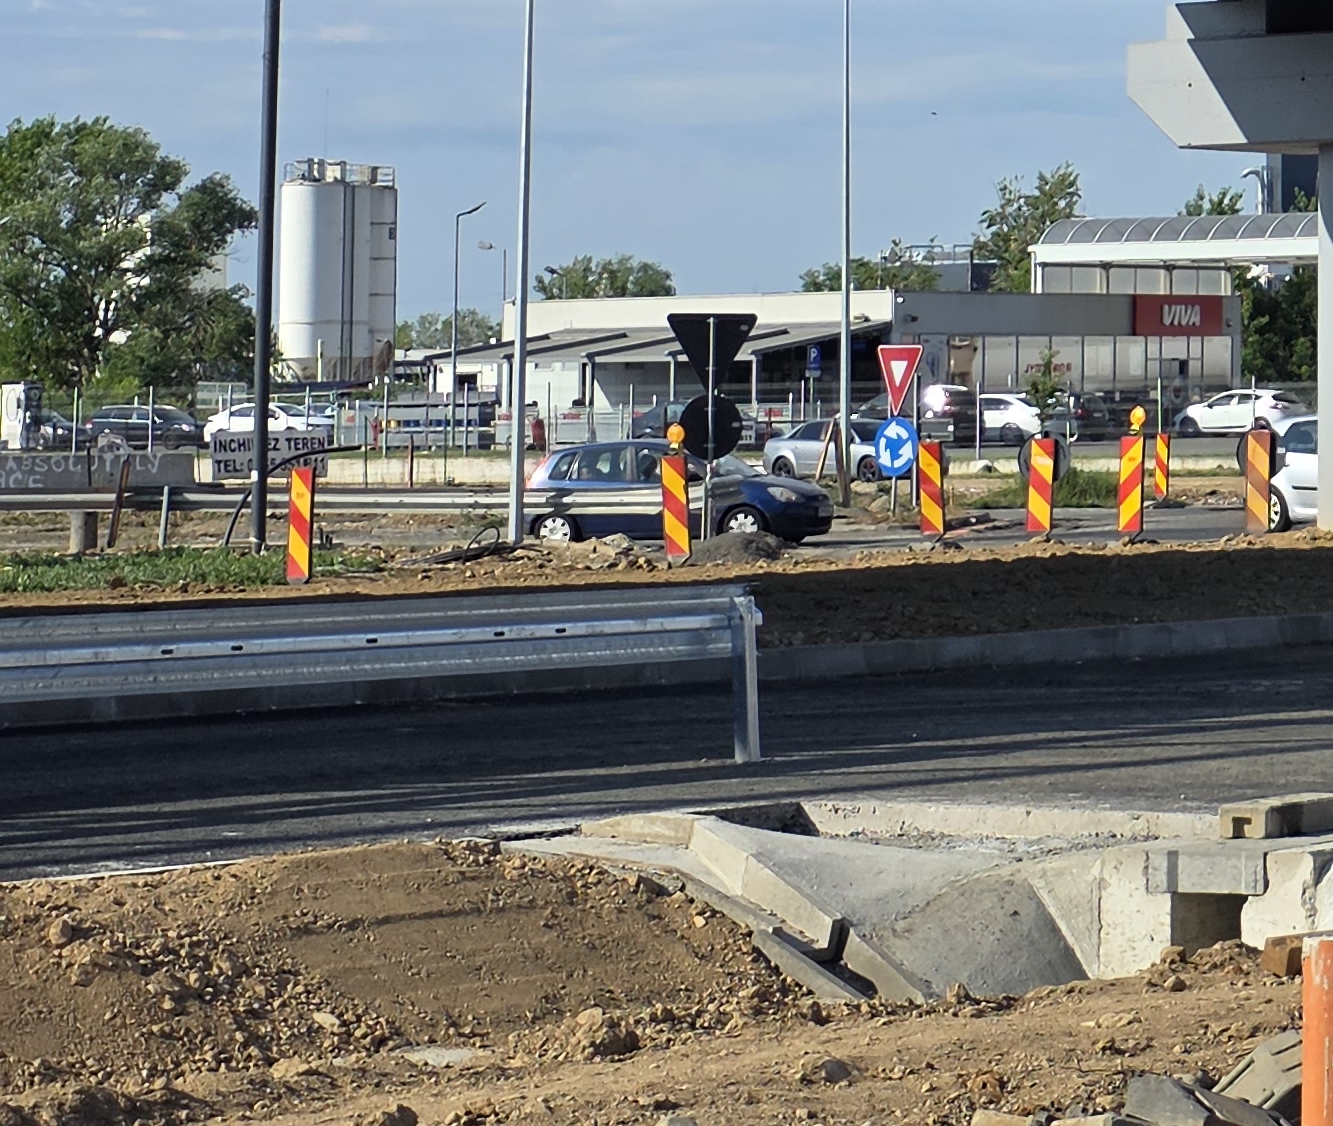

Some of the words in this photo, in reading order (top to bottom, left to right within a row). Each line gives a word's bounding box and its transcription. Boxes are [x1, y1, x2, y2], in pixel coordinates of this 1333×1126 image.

[1162, 303, 1201, 327] VIVA
[213, 437, 281, 453] INCHIEZ
[285, 436, 326, 451] TEREN
[6, 451, 162, 473] ABSOLUTLY
[214, 458, 244, 473] TEL:
